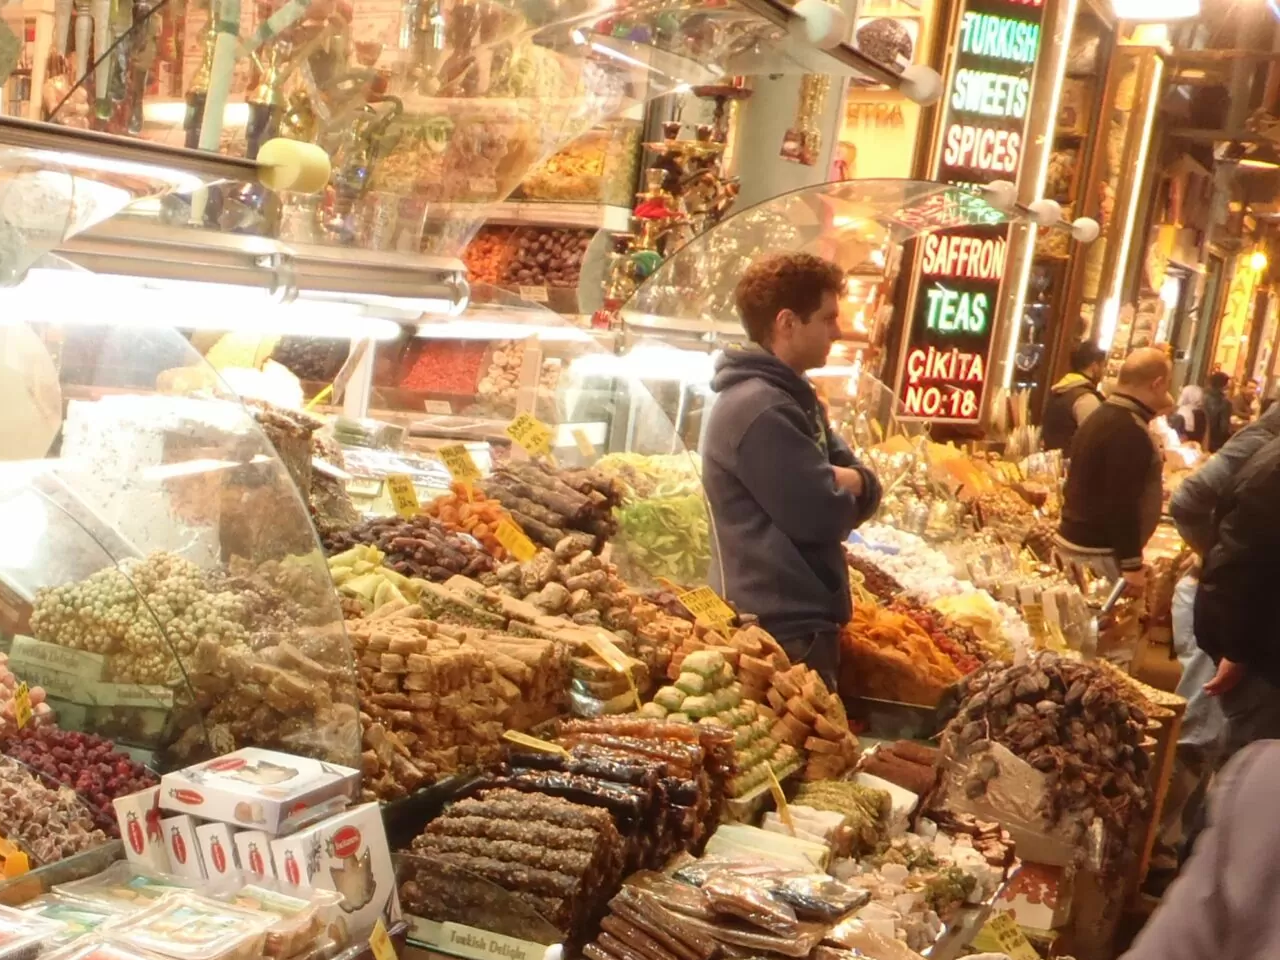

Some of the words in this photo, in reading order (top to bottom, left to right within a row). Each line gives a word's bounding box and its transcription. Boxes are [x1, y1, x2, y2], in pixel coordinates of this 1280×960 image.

[962, 11, 1040, 62] TURKISH
[952, 68, 1029, 119] SWEETS
[944, 124, 1019, 172] SPICES
[922, 233, 1006, 281] SAFFRON
[927, 289, 988, 333] TEAS
[907, 346, 984, 384] ÇİKİTA
[904, 386, 977, 417] NO:18
[449, 929, 486, 951] Turkish
[488, 939, 526, 960] Delight
